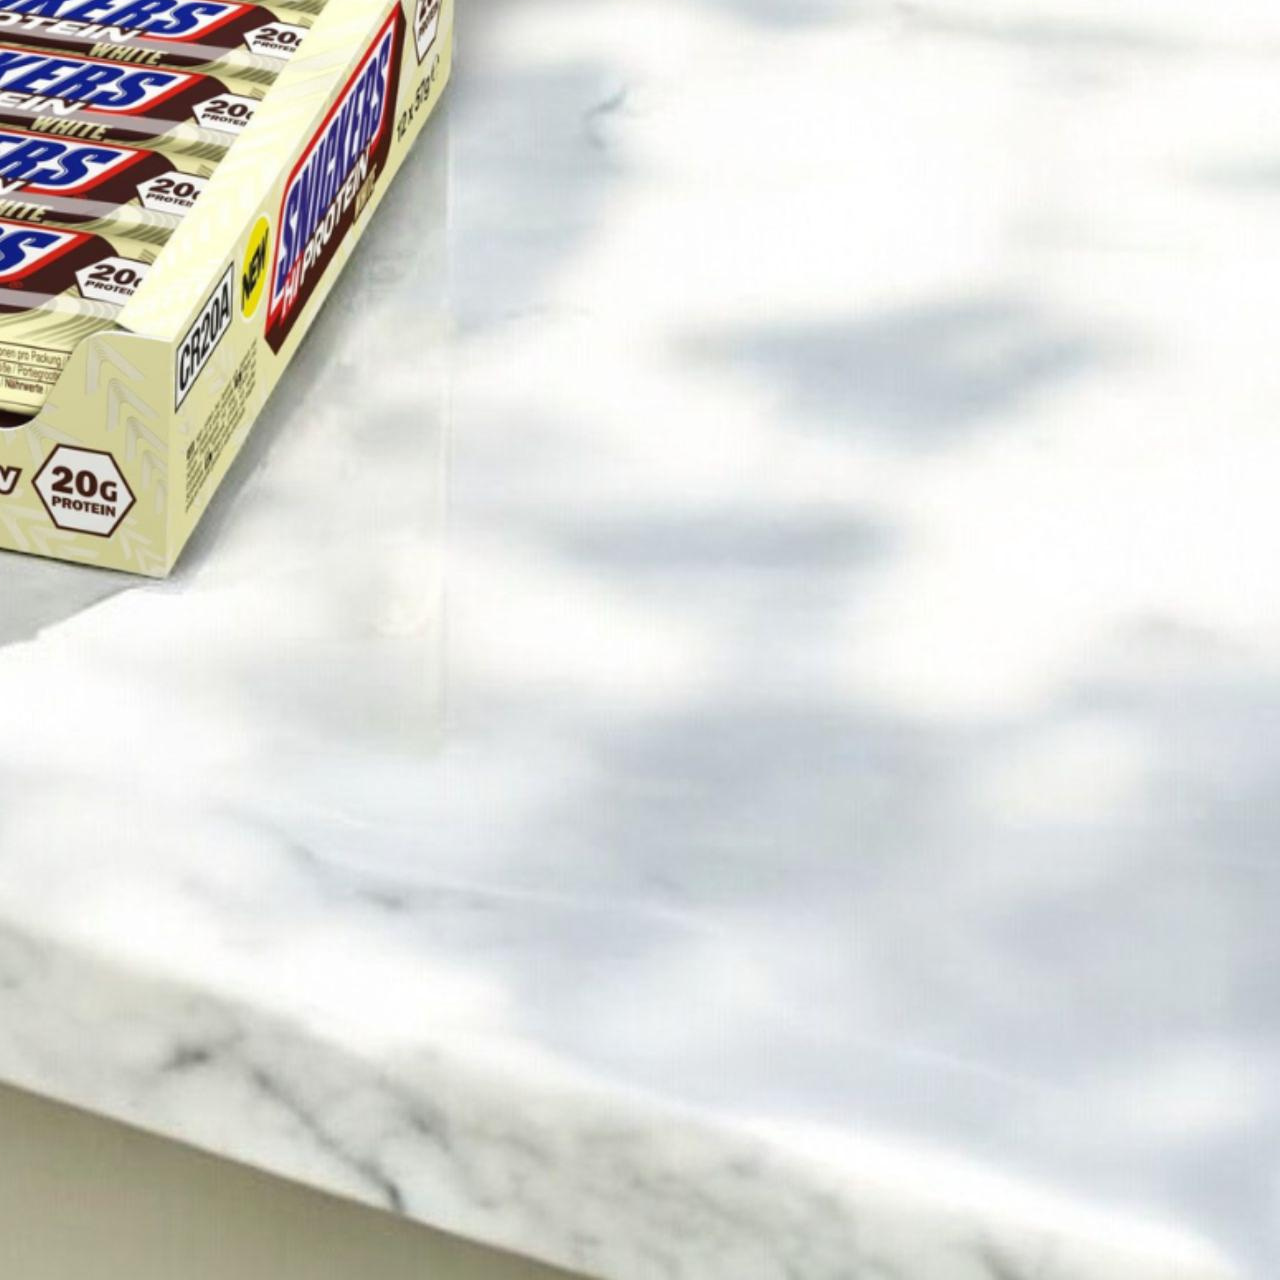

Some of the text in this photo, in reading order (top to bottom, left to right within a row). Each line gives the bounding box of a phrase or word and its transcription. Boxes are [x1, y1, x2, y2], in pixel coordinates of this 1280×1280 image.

[87, 42, 167, 65] WHITE
[30, 116, 113, 140] WHITE
[274, 32, 392, 300] SNICKERS
[302, 149, 370, 273] PROTEIN
[241, 227, 270, 311] NEW
[179, 282, 231, 392] CR20A
[51, 466, 118, 502] 20G
[51, 496, 117, 518] PROTEIN
